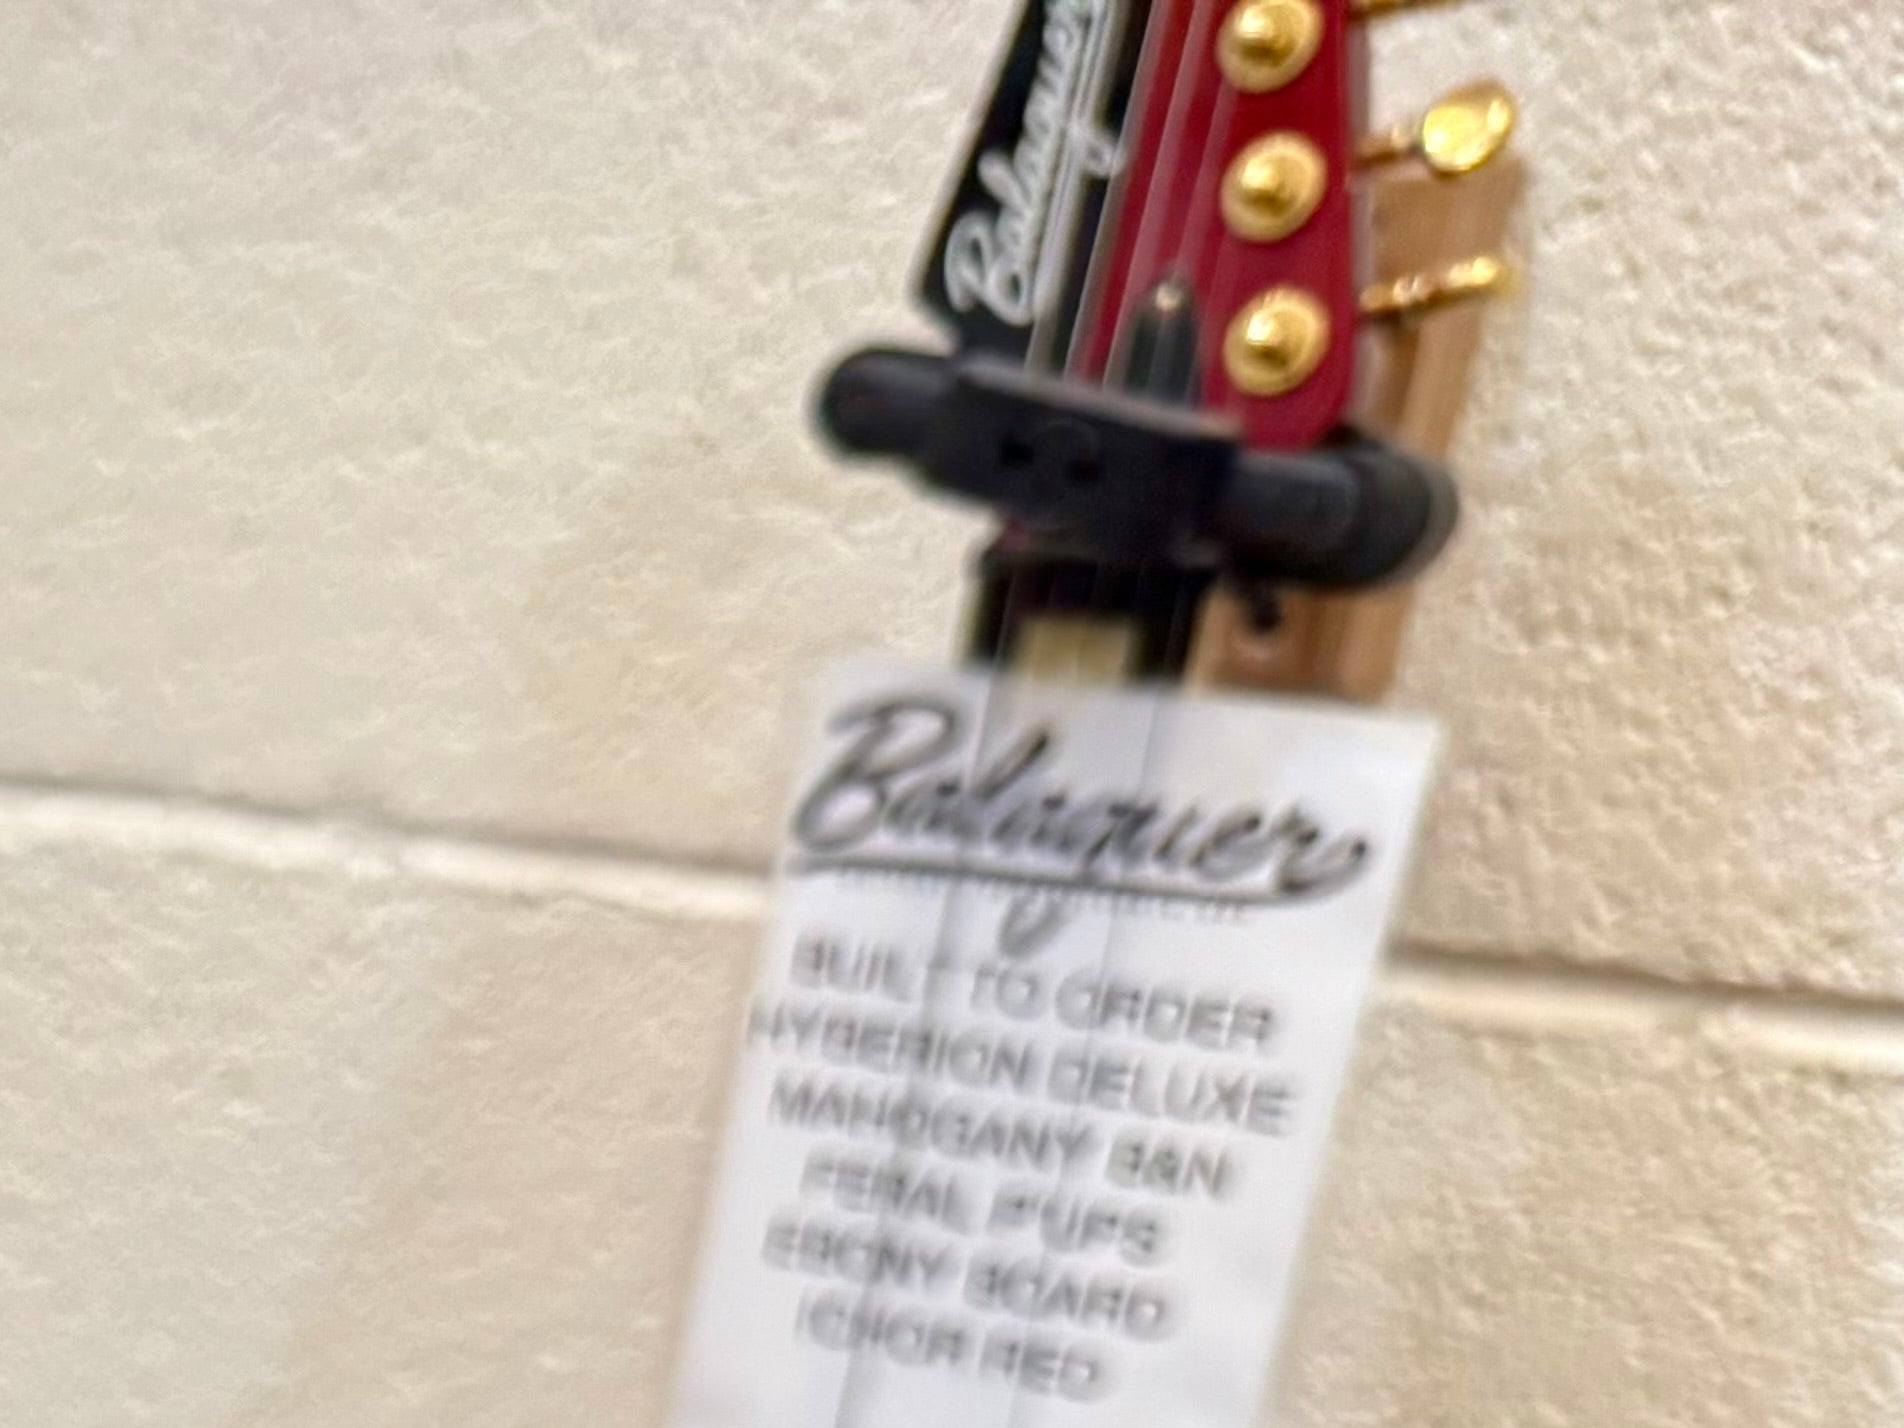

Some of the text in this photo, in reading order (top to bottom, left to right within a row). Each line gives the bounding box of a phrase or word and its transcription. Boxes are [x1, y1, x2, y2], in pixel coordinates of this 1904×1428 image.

[788, 694, 1370, 958] Balaguer
[791, 932, 1276, 1054] BUILT TO ORDER
[768, 1066, 1096, 1172] MAHOGANY
[1047, 1032, 1296, 1136] DELUXE
[761, 1209, 1180, 1343] EBONY BOARD
[979, 1321, 1114, 1403] RED
